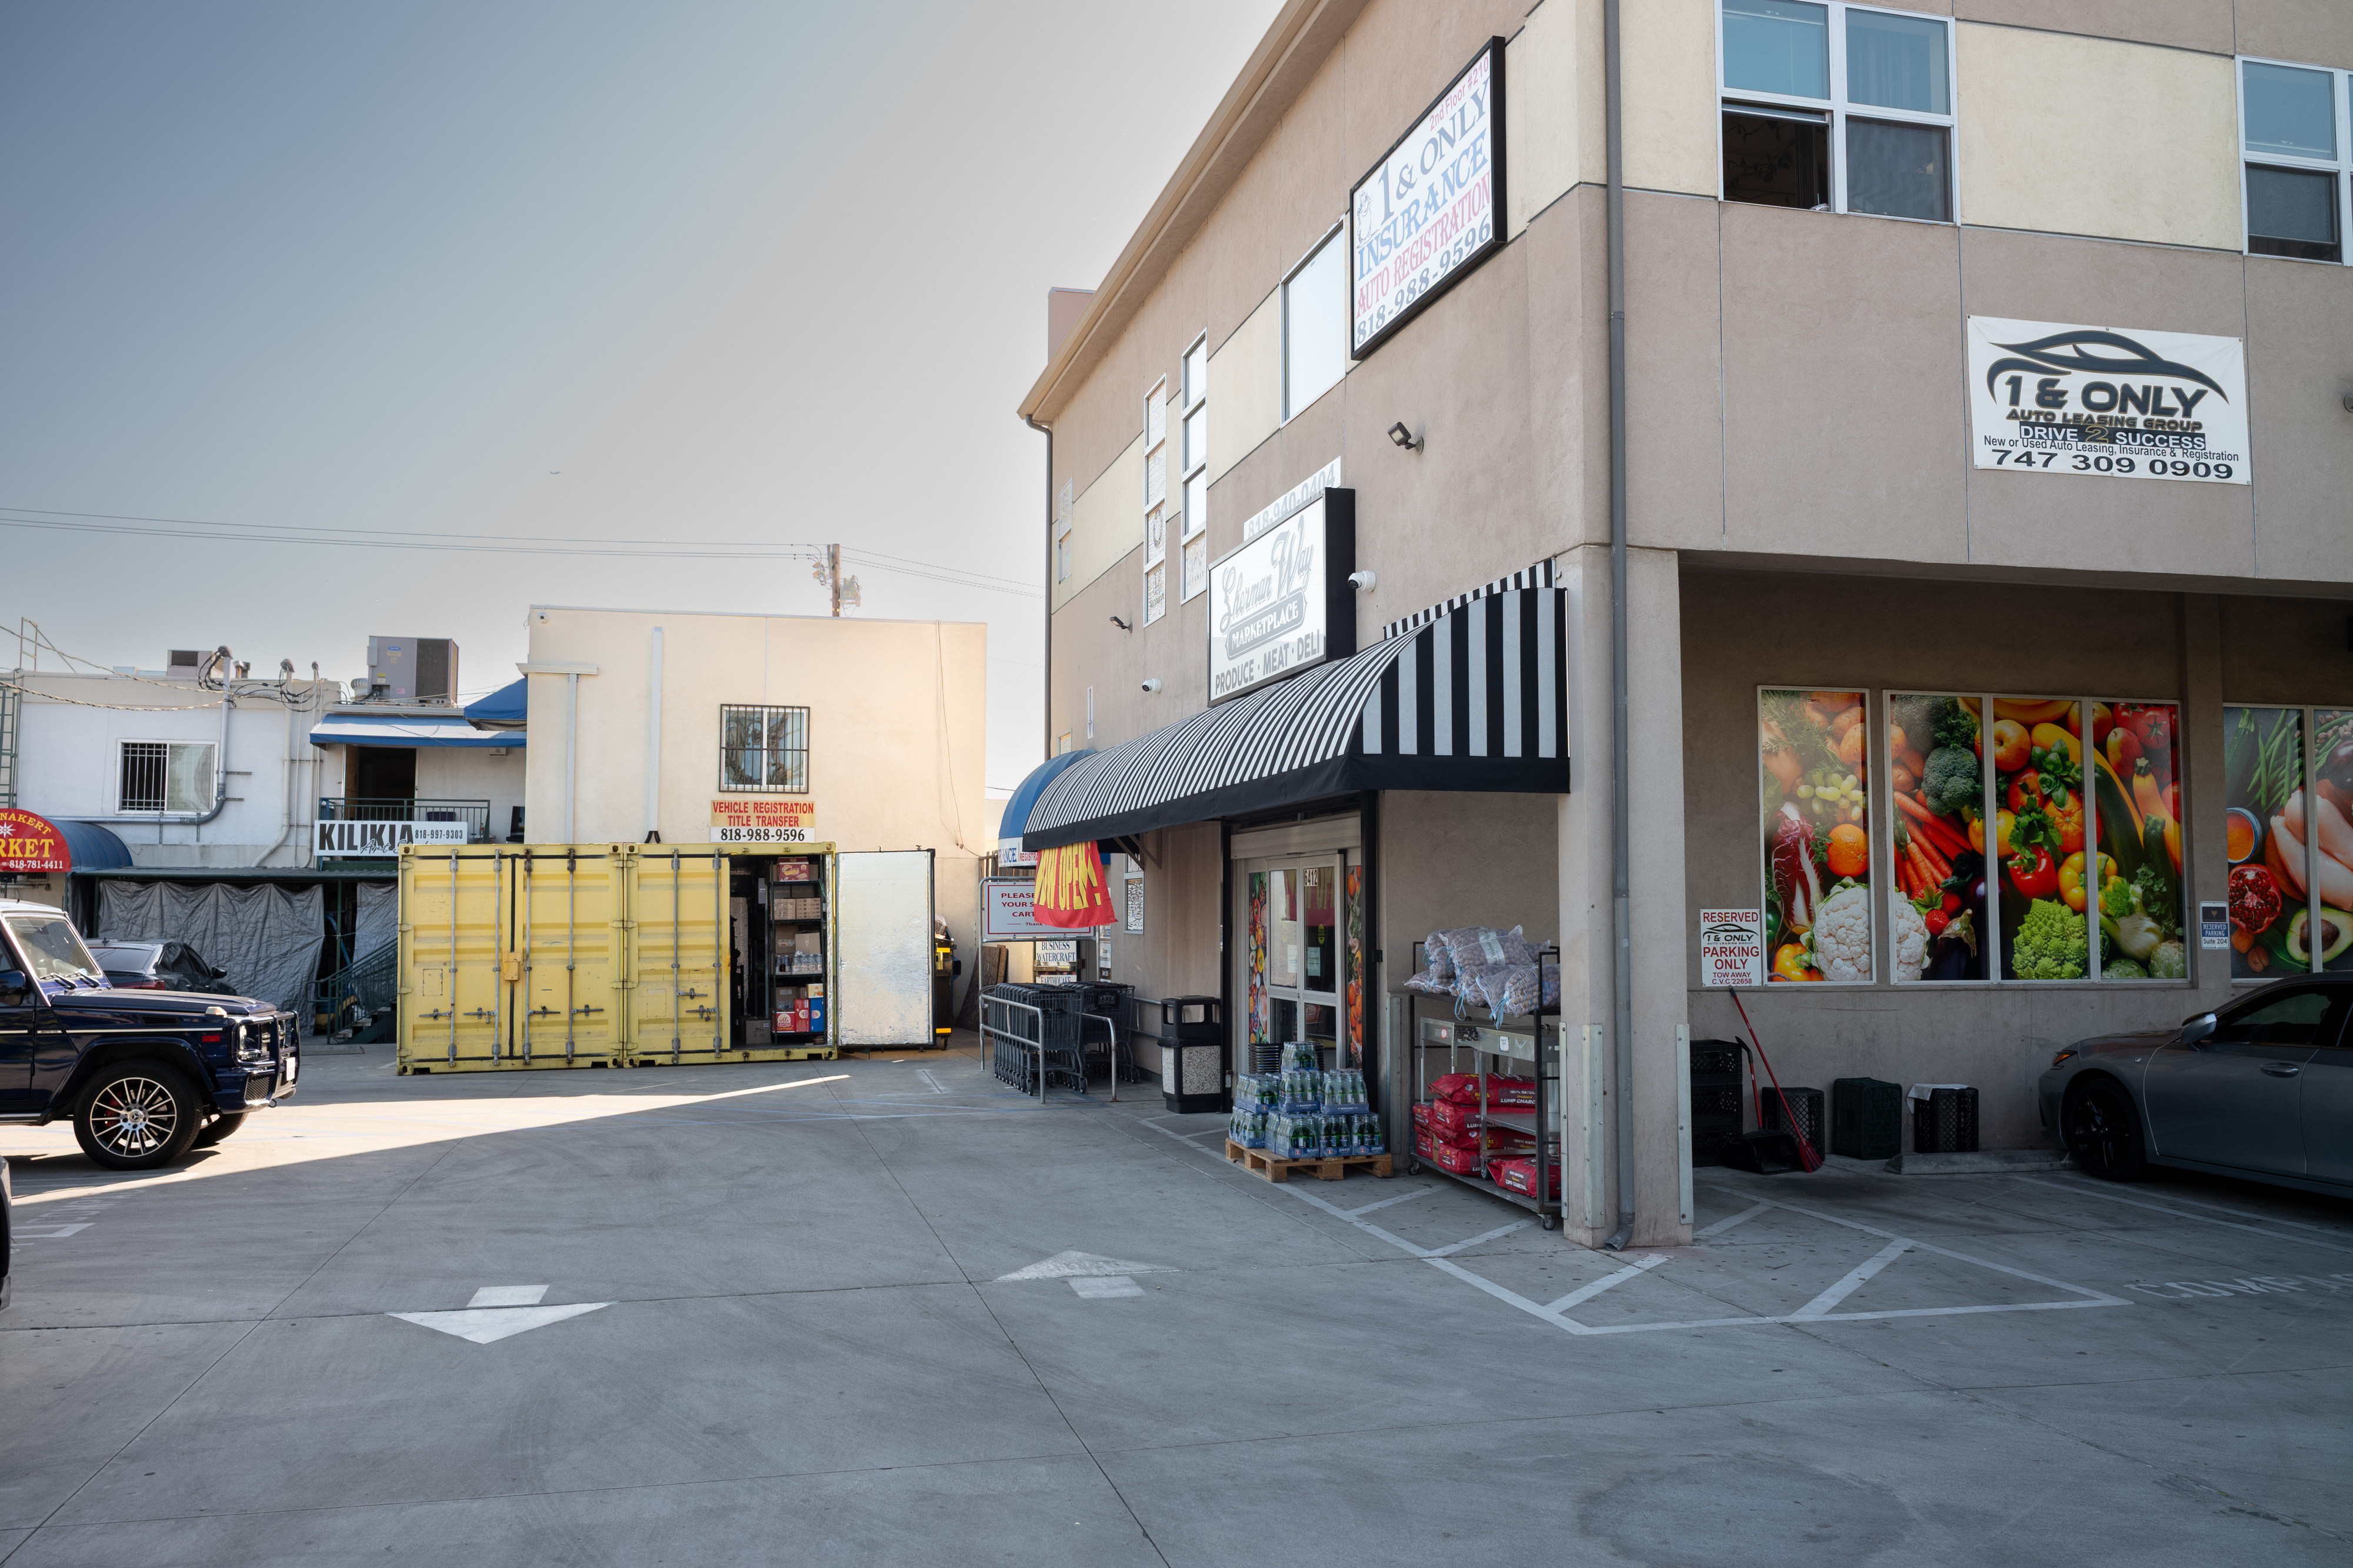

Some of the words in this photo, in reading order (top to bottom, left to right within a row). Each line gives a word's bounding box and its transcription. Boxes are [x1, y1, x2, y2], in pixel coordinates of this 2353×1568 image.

[1429, 104, 1444, 132] 2nd
[1445, 84, 1465, 114] Floor
[1468, 56, 1489, 91] #210
[1378, 161, 1394, 226] 1
[1395, 164, 1417, 201] &
[1419, 75, 1490, 176] ONLY
[1358, 127, 1488, 282] INSURANCE
[1357, 267, 1389, 319] AUTO
[1393, 169, 1491, 289] REGISTRATION
[1357, 213, 1491, 345] 818-988-9596
[2005, 375, 2022, 406] 1
[2035, 378, 2068, 410] &
[2081, 381, 2208, 419] ONLY
[2006, 409, 2056, 423] AUTO
[2062, 412, 2137, 428] LEASING
[2143, 418, 2203, 432] GROUP
[1984, 435, 2005, 447] New
[2008, 439, 2019, 448] or
[2022, 438, 2047, 449] Used
[2049, 441, 2072, 451] Auto
[2076, 442, 2117, 456] Leasing,
[2119, 444, 2167, 457] Insurance
[2169, 448, 2177, 457] &
[2182, 448, 2239, 462] Registration
[2020, 425, 2078, 442] DRIVE
[2085, 425, 2109, 443] 2
[2115, 432, 2205, 450] SUCCESS
[1992, 449, 2058, 468] 747
[2071, 455, 2135, 473] 309
[2149, 459, 2233, 479] 0909
[1220, 566, 1272, 634] Sherman
[1271, 515, 1314, 602] Way
[1231, 600, 1299, 650] MARKETPLACE
[1215, 659, 1254, 695] PRODUCE
[1263, 642, 1289, 676] MEAT
[1297, 629, 1319, 661] DELI
[713, 802, 748, 813] VEHICLE
[754, 802, 814, 814] REGISTRATION
[728, 815, 751, 826] TITLE
[756, 816, 799, 827] TRANSFER
[319, 824, 414, 850] KILIKIA
[415, 830, 463, 839] 818-997-9303
[721, 828, 805, 841] 818-988-9596
[9, 860, 63, 869] 818-781-4411
[1020, 852, 1038, 861] REGISTRA
[1304, 870, 1317, 885] 6412
[1703, 912, 1758, 922] RESERVED
[1037, 952, 1075, 962] WATERCRAFT
[1042, 941, 1070, 950] BUSINESS
[1703, 946, 1759, 958] PARKING
[1714, 959, 1748, 969] ONLY
